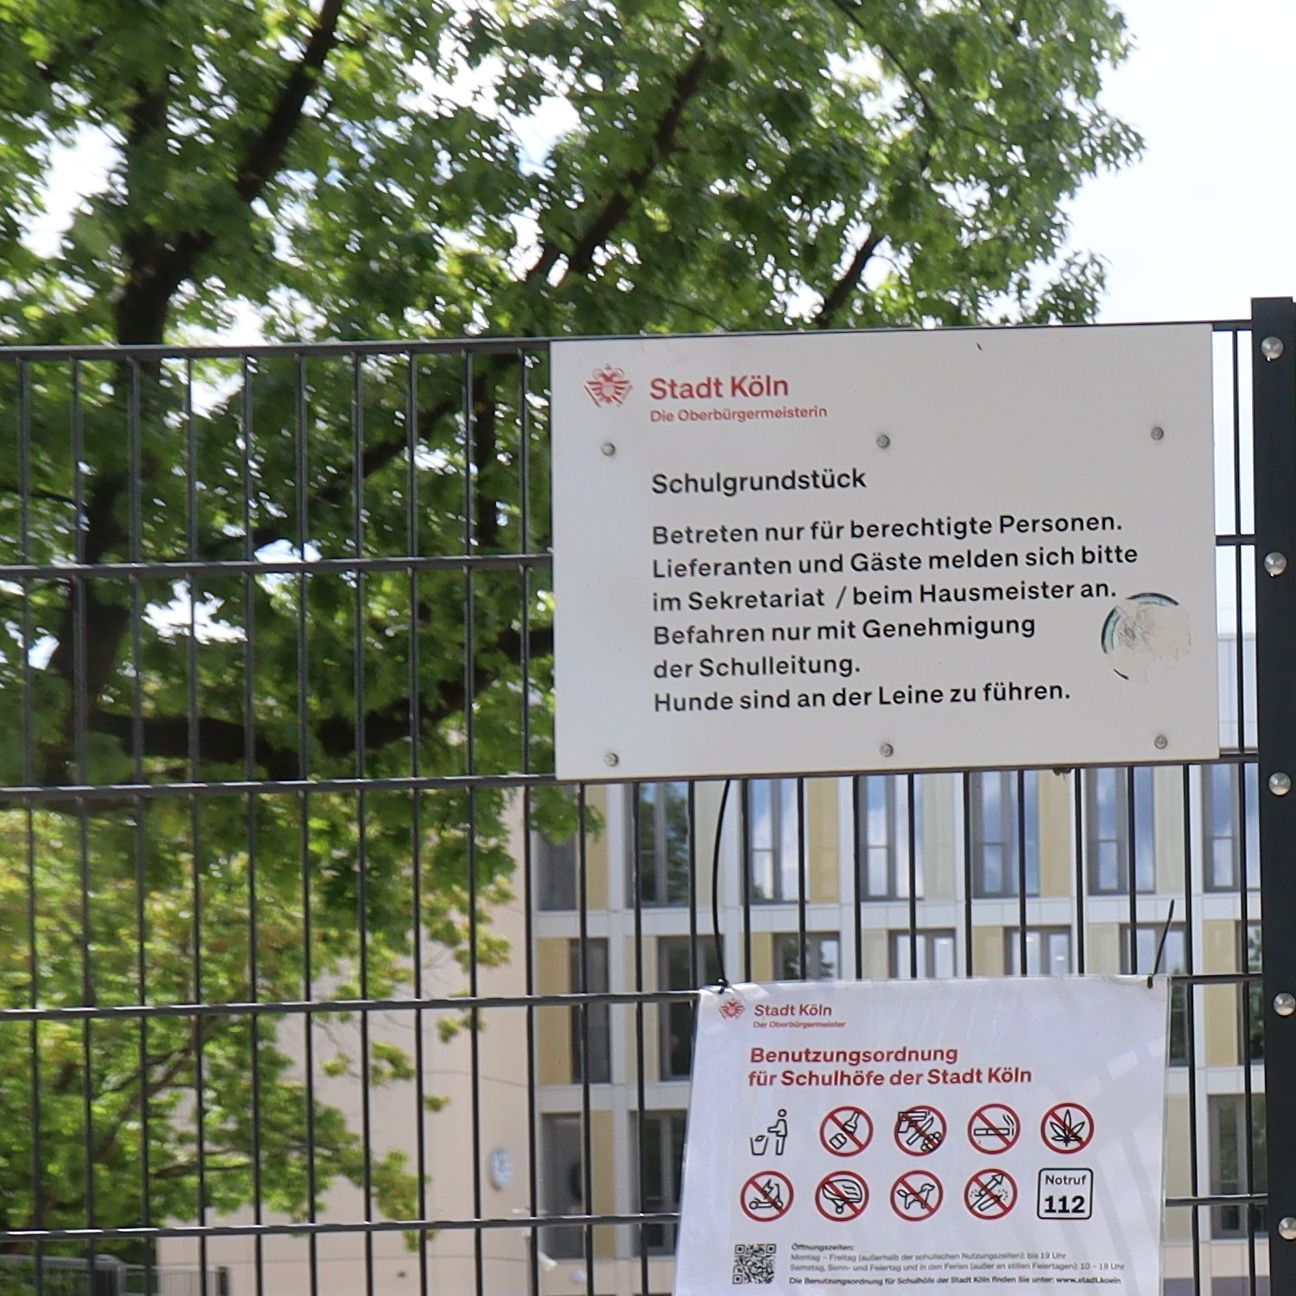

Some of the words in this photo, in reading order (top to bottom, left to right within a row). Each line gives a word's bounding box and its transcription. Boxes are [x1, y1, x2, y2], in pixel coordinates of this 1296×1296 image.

[650, 376, 723, 400] Stadt
[731, 374, 788, 397] Köln
[650, 409, 674, 422] Die
[677, 405, 827, 422] Oberbürgermeisterin
[652, 467, 866, 497] Schulgrundstück
[653, 525, 757, 544] Betreten
[765, 526, 804, 541] nur
[810, 520, 844, 539] für
[850, 516, 992, 540] berechtigte
[999, 514, 1121, 534] Personen.
[653, 557, 791, 578] Lieferanten
[799, 553, 843, 574] und
[850, 552, 921, 572] Gäste
[929, 548, 1018, 569] melden
[1025, 546, 1074, 566] sich
[1081, 544, 1137, 564] bitte
[653, 592, 681, 611] im
[688, 588, 824, 610] Sekretariat
[836, 586, 846, 609] /
[853, 585, 912, 605] beim
[920, 580, 1074, 603] Hausmeister
[1080, 583, 1116, 598] an.
[654, 624, 764, 645] Befahren
[772, 626, 811, 641] nur
[817, 620, 856, 640] mit
[862, 615, 1035, 640] Genehmigung
[654, 659, 693, 678] der
[699, 655, 860, 678] Schulleitung.
[655, 691, 733, 711] Hunde
[740, 689, 790, 710] sind
[797, 693, 825, 708] an
[832, 687, 872, 706] der
[879, 684, 943, 705] Leine
[950, 688, 976, 703] zu
[983, 681, 1070, 701] führen.
[754, 1004, 795, 1016] Stadt
[799, 1003, 832, 1016] Köln
[750, 1046, 957, 1066] Benutzungsordnung
[748, 1070, 777, 1086] für
[781, 1070, 884, 1086] Schulhöfe
[889, 1069, 923, 1085] der
[927, 1068, 982, 1085] Stadt
[988, 1067, 1031, 1083] Köln
[1045, 1174, 1086, 1185] Notruf
[1044, 1195, 1085, 1213] 112
